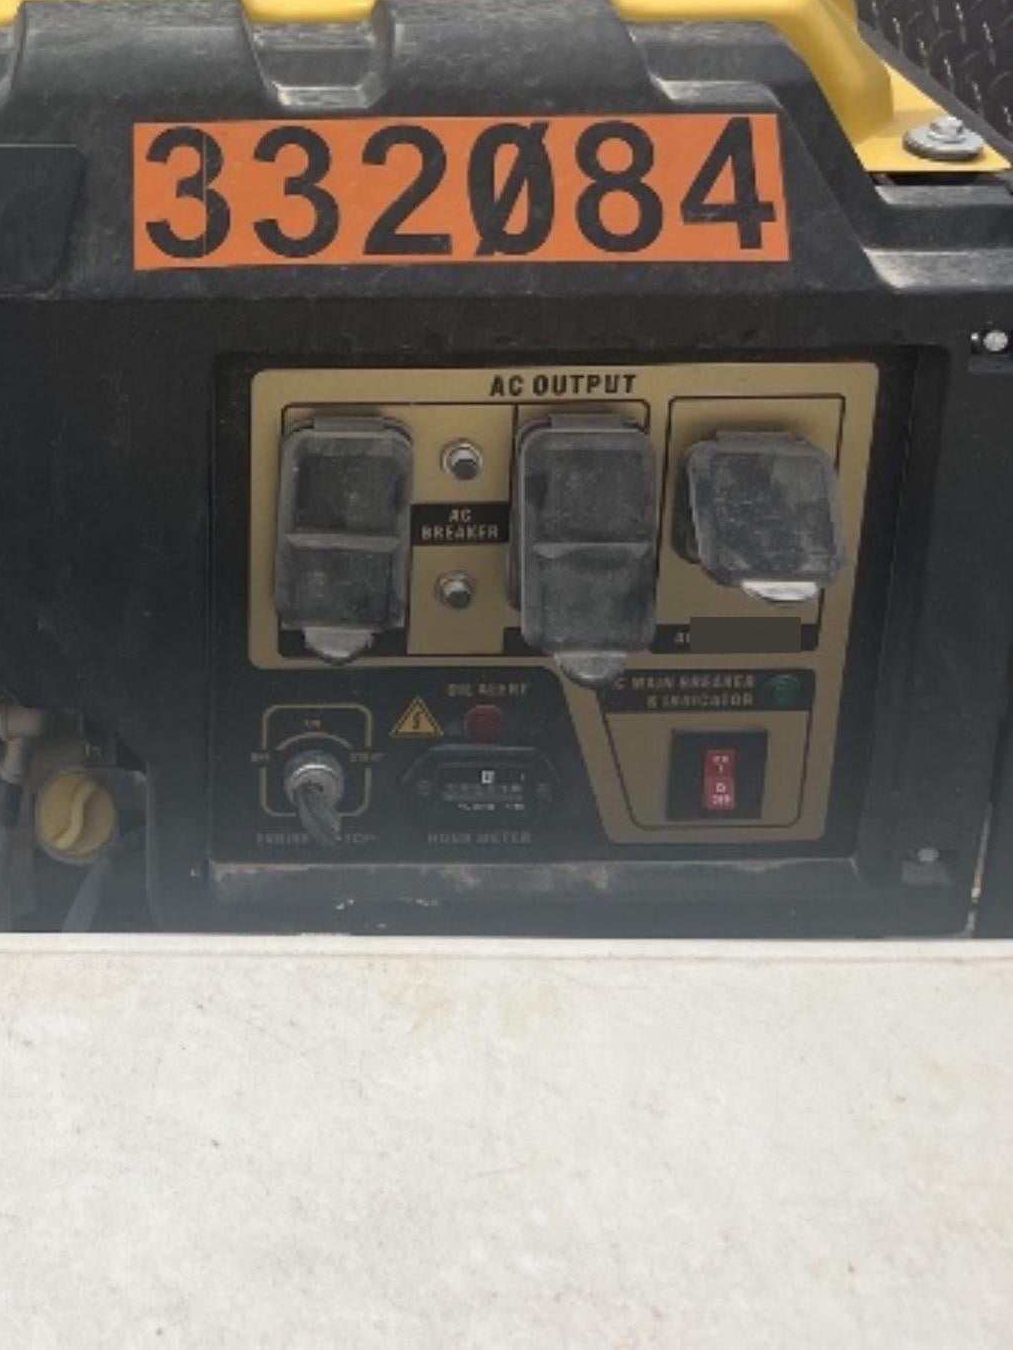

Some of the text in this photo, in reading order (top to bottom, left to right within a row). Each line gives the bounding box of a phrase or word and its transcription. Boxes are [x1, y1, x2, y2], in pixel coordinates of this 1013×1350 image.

[145, 116, 777, 259] 332084
[489, 373, 637, 397] AC OUTPUT
[448, 508, 472, 522] AC
[421, 523, 499, 542] BREAKER
